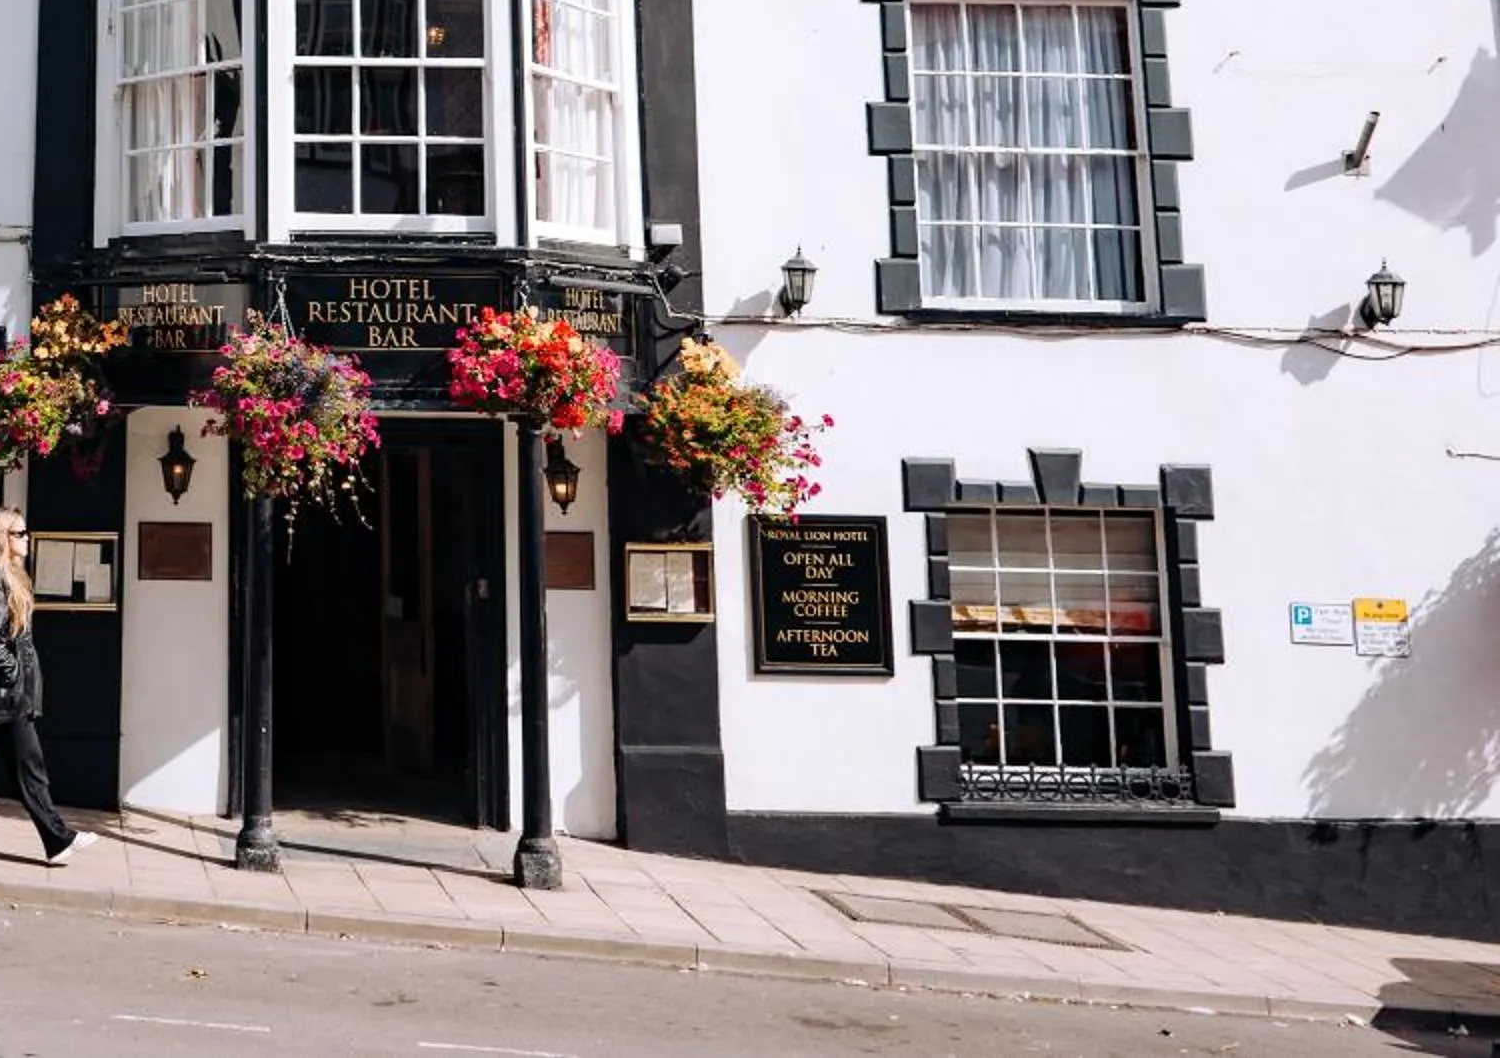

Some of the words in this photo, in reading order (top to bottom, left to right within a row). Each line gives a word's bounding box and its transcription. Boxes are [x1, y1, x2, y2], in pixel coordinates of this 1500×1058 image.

[142, 283, 198, 303] HOTEL
[349, 278, 436, 301] HOTEL
[565, 287, 606, 310] HOTEL
[117, 305, 225, 327] RESTAURANT
[307, 301, 477, 324] RESTAURANT
[154, 330, 187, 349] BAR
[367, 325, 419, 348] BAR
[767, 529, 800, 541] ROYAL
[802, 530, 831, 541] LION
[833, 531, 869, 542] HOTEL
[783, 551, 825, 565] OPEN
[829, 553, 855, 567] ALL
[806, 565, 835, 579] DAY
[782, 590, 860, 605] MORNING
[794, 603, 849, 617] COFFEE
[1297, 607, 1310, 623] P
[777, 629, 869, 643] AFTERNOON
[810, 643, 839, 657] TEA
